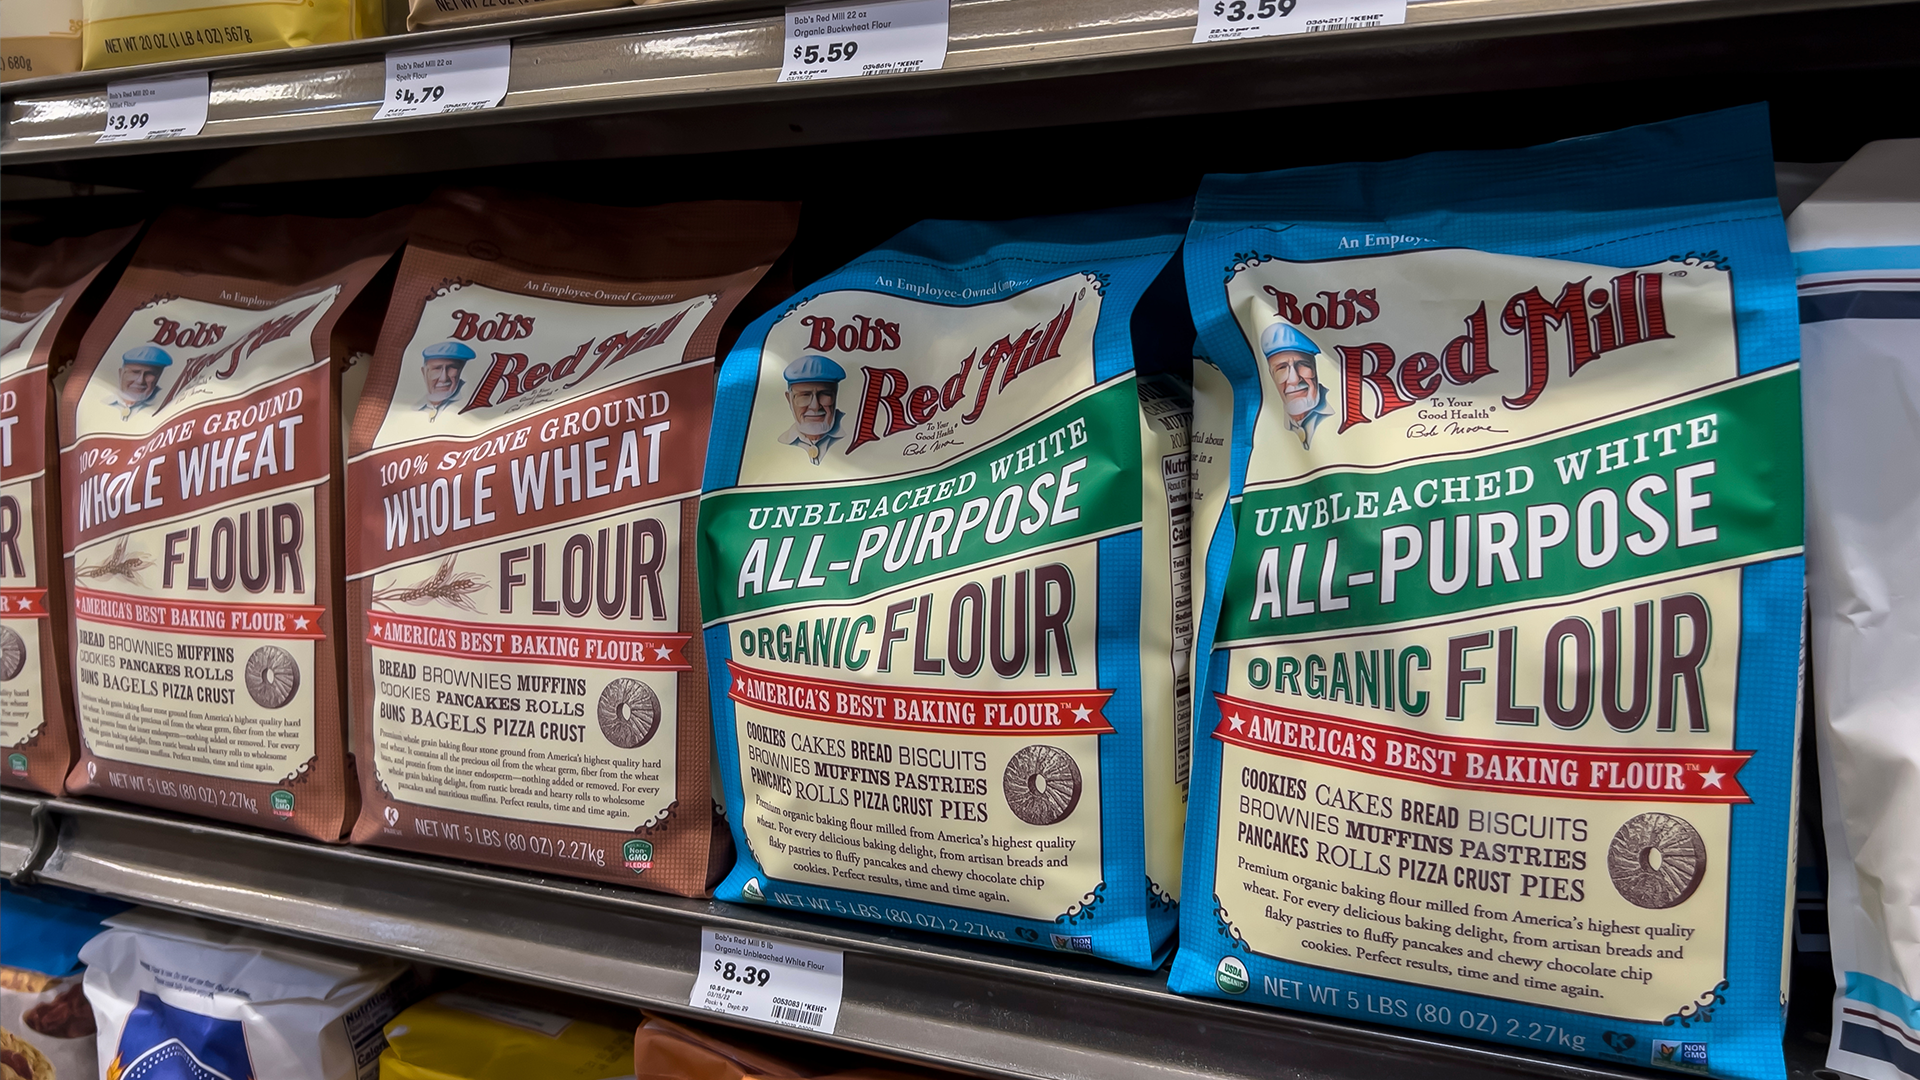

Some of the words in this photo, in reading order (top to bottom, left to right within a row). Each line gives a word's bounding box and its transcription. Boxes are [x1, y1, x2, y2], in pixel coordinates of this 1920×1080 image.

[794, 27, 825, 37] Organic
[827, 23, 869, 34] Buckwheat
[872, 21, 891, 29] Flour
[795, 16, 814, 25] Bob's
[847, 12, 856, 20] 22
[1214, 0, 1295, 22] $3.59
[105, 38, 122, 53] NET
[124, 36, 139, 51] WT
[140, 35, 152, 50] 20
[154, 33, 168, 48] OZ
[169, 32, 179, 47] (1
[182, 30, 193, 46] LB
[196, 30, 203, 44] 4
[205, 27, 223, 43] OZ)
[226, 26, 252, 43] 567g
[794, 41, 858, 65] $5.59
[8, 56, 32, 71] 680g
[397, 73, 411, 82] Spelt
[412, 72, 427, 80] Flour
[413, 61, 424, 69] Red
[396, 86, 444, 104] $4.79
[109, 113, 149, 130] $3.99
[1338, 237, 1359, 249] An
[524, 280, 539, 290] An
[542, 282, 629, 301] Employee-Owned
[631, 291, 676, 301] Company
[875, 276, 893, 287] An
[898, 278, 997, 299] Employee-Owned
[448, 309, 536, 342] Bob's
[1263, 285, 1380, 331] Bob's
[148, 317, 227, 348] Bob's
[801, 315, 901, 353] Bob's
[1336, 301, 1499, 434] Red
[1501, 270, 1675, 410] Mill
[458, 337, 596, 415] Red
[846, 350, 976, 455] Red
[962, 292, 1078, 425] Mill
[1417, 409, 1447, 420] Good
[1431, 398, 1443, 408] To
[1447, 398, 1473, 408] Your
[80, 448, 120, 474] 100%
[127, 420, 195, 465] STONE
[203, 387, 302, 435] GROUND
[381, 454, 429, 486] 100%
[437, 427, 531, 470] STONE
[540, 391, 670, 442] GROUND
[79, 455, 165, 532] WHOLE
[178, 415, 303, 500] WHEAT
[383, 464, 496, 551] WHOLE
[510, 421, 670, 516] WHEAT
[747, 470, 977, 530] UNBLEACHED
[990, 417, 1087, 483] WHITE
[1255, 467, 1534, 536] UNBLEACHED
[1555, 414, 1719, 485] WHITE
[737, 457, 1089, 599] ALL-PURPOSE
[1249, 460, 1719, 621] ALL-PURPOSE
[162, 502, 305, 594] FLOUR
[499, 518, 667, 621] FLOUR
[81, 597, 132, 620] AMERICA'S
[136, 605, 166, 624] BEST
[171, 611, 225, 629] BAKING
[740, 614, 877, 672] ORGANIC
[877, 562, 1077, 679] FLOUR
[384, 622, 456, 648] AMERICA'S
[461, 632, 505, 652] BEST
[511, 639, 580, 659] BAKING
[1248, 645, 1430, 715] ORGANIC
[1445, 592, 1710, 732] FLOUR
[747, 675, 830, 712] AMERICA'S
[837, 692, 887, 719] BEST
[894, 699, 976, 725] BAKING
[746, 720, 786, 749] COOKIES
[791, 732, 846, 759] CAKES
[851, 741, 893, 764] BREAD
[899, 746, 987, 772] BISCUITS
[1248, 713, 1376, 760] AMERICA'S
[1385, 741, 1456, 774] BEST
[1466, 753, 1579, 786] BAKING
[748, 745, 810, 776] BROWNIES
[815, 761, 891, 787] MUFFINS
[895, 772, 988, 796] PASTRIES
[751, 767, 792, 798] PANCAKES
[796, 780, 850, 807] ROLLS
[854, 790, 889, 811] PIZZA
[893, 796, 933, 818] CRUST
[941, 801, 988, 823] PIES
[1241, 766, 1307, 801] COOKIES
[1315, 784, 1393, 820] CAKES
[1400, 799, 1460, 830] BREAD
[1468, 810, 1588, 842] BISCUITS
[1239, 796, 1340, 835] BROWNIES
[1345, 820, 1454, 856] MUFFINS
[1460, 839, 1587, 871] PASTRIES
[1238, 821, 1309, 859] PANCAKES
[1316, 843, 1392, 877] ROLLS
[1399, 860, 1448, 887] PIZZA
[1454, 868, 1511, 894] CRUST
[1521, 875, 1586, 902] PIES
[1238, 856, 1288, 881] Premium
[1292, 875, 1337, 892] organic
[1341, 882, 1386, 904] baking
[1389, 891, 1422, 908] flour
[1426, 900, 1469, 917] milled
[1474, 904, 1508, 921] from
[1512, 911, 1583, 931] America's
[1588, 919, 1640, 936] highest
[1645, 923, 1695, 940] quality
[715, 933, 732, 942] Bob's
[734, 936, 746, 944] Red
[715, 944, 742, 955] Organic
[744, 949, 784, 963] Unbleached
[785, 957, 805, 967] White
[807, 961, 824, 970] Flour
[714, 959, 770, 987] $8.39
[1219, 973, 1244, 988] ORGANIC
[1224, 963, 1242, 978] USDA
[773, 997, 800, 1007] 0053083
[1264, 975, 1300, 1000] NET
[1307, 981, 1340, 1006] WT
[1347, 992, 1359, 1010] 5
[1367, 995, 1408, 1018] LBS
[1416, 1004, 1452, 1025] (80
[1459, 1009, 1498, 1035] OZ)
[1506, 1018, 1586, 1051] 2.27kg
[1684, 1044, 1705, 1052] NON
[1684, 1051, 1706, 1059] GMO
